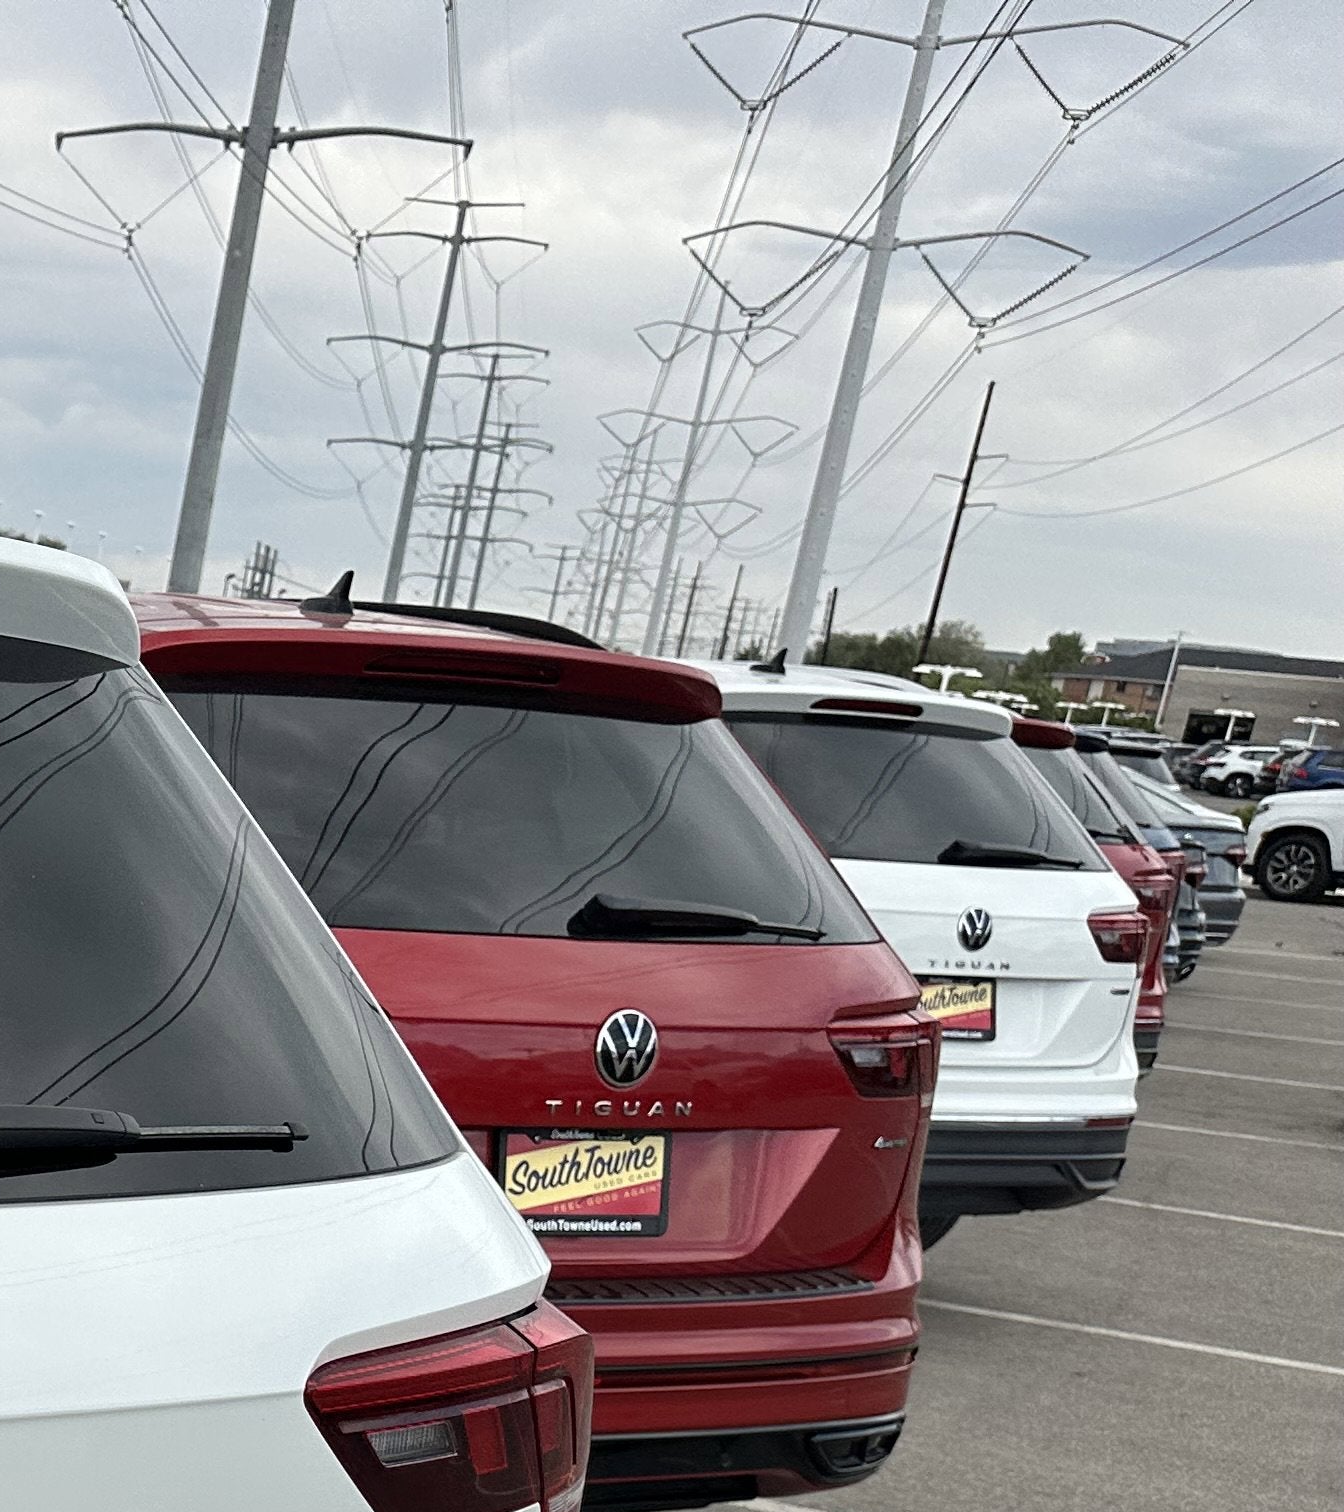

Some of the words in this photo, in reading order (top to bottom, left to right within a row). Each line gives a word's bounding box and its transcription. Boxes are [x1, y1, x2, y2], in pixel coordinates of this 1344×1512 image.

[928, 960, 1010, 970] TIGUAN
[545, 1100, 692, 1116] TIGUAN
[509, 1145, 657, 1195] SouthTowne
[527, 1219, 642, 1231] SouthTowneUsed.com
